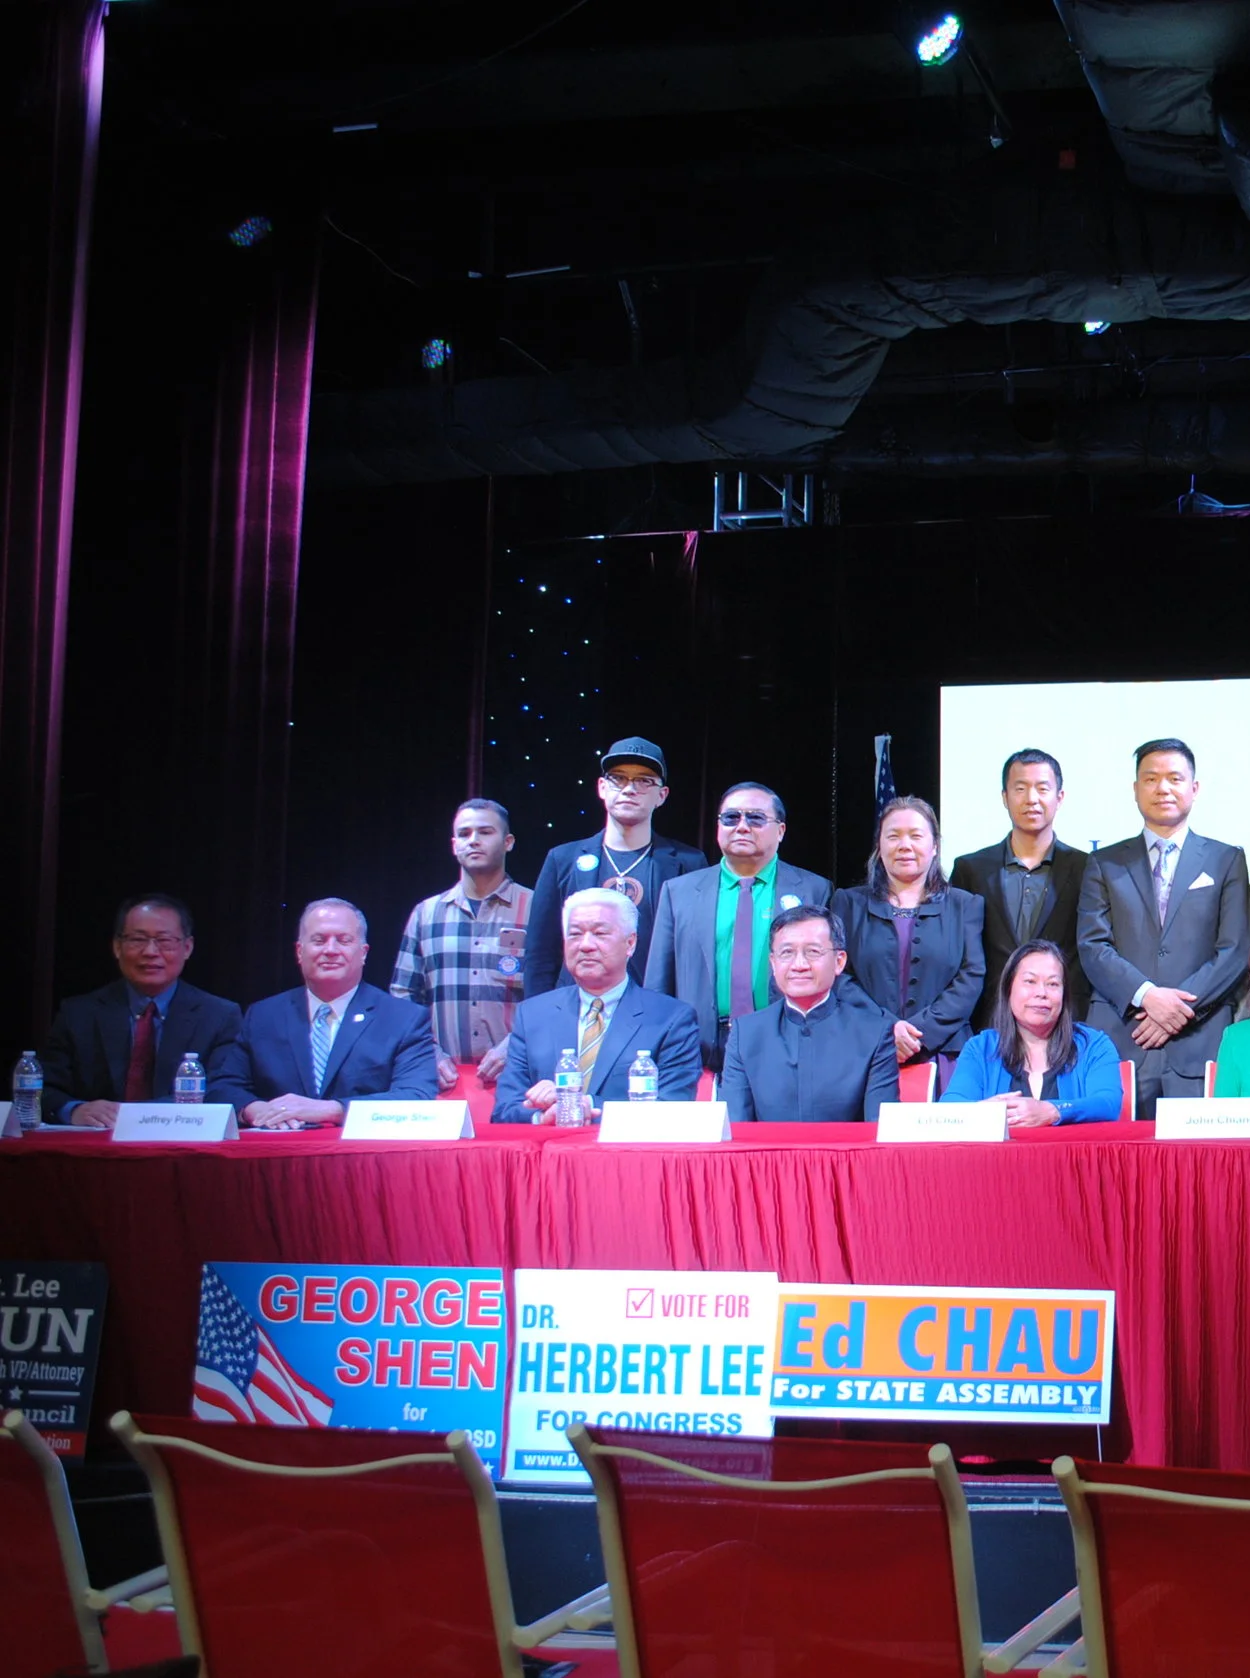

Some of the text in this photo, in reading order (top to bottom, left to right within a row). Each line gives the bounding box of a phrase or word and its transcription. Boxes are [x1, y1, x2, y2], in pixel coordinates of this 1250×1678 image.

[139, 1114, 204, 1127] Jeffrey Prang
[13, 1273, 60, 1298] Lee
[259, 1274, 503, 1329] GEORGE
[661, 1294, 750, 1319] VOTE FOR
[522, 1304, 559, 1329] DR.
[0, 1306, 94, 1354] UN
[780, 1300, 1100, 1375] Ed CHAU
[10, 1359, 85, 1387] VP/Attorney
[335, 1337, 498, 1390] SHEN
[518, 1342, 765, 1396] HERBERT LEE
[772, 1377, 1098, 1406] For STATE ASSEMBLY
[24, 1405, 76, 1424] uncil
[403, 1402, 427, 1421] for
[536, 1410, 742, 1435] FOR CONGRESS
